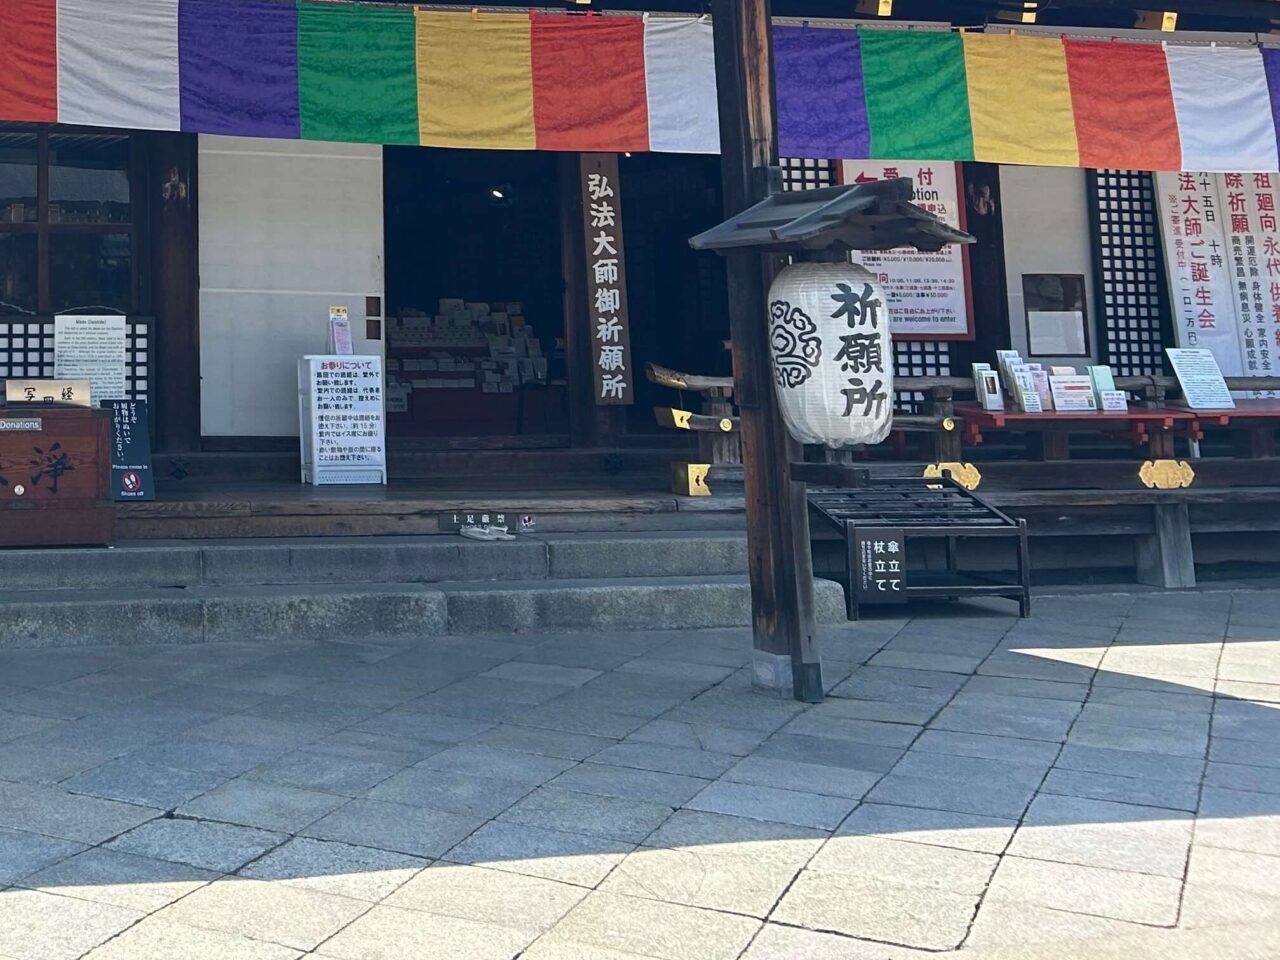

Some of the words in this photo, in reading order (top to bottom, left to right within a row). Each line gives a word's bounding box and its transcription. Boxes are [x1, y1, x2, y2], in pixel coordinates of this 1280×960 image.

[1224, 172, 1250, 234] 除祈願
[1179, 172, 1216, 329] 法大師ご誕生会
[588, 173, 627, 399] 弘法大師御祈願所
[830, 283, 888, 420] 祈願所
[0, 420, 40, 429] Donations
[874, 540, 886, 591] 杖立て
[888, 540, 900, 590] 傘立て
